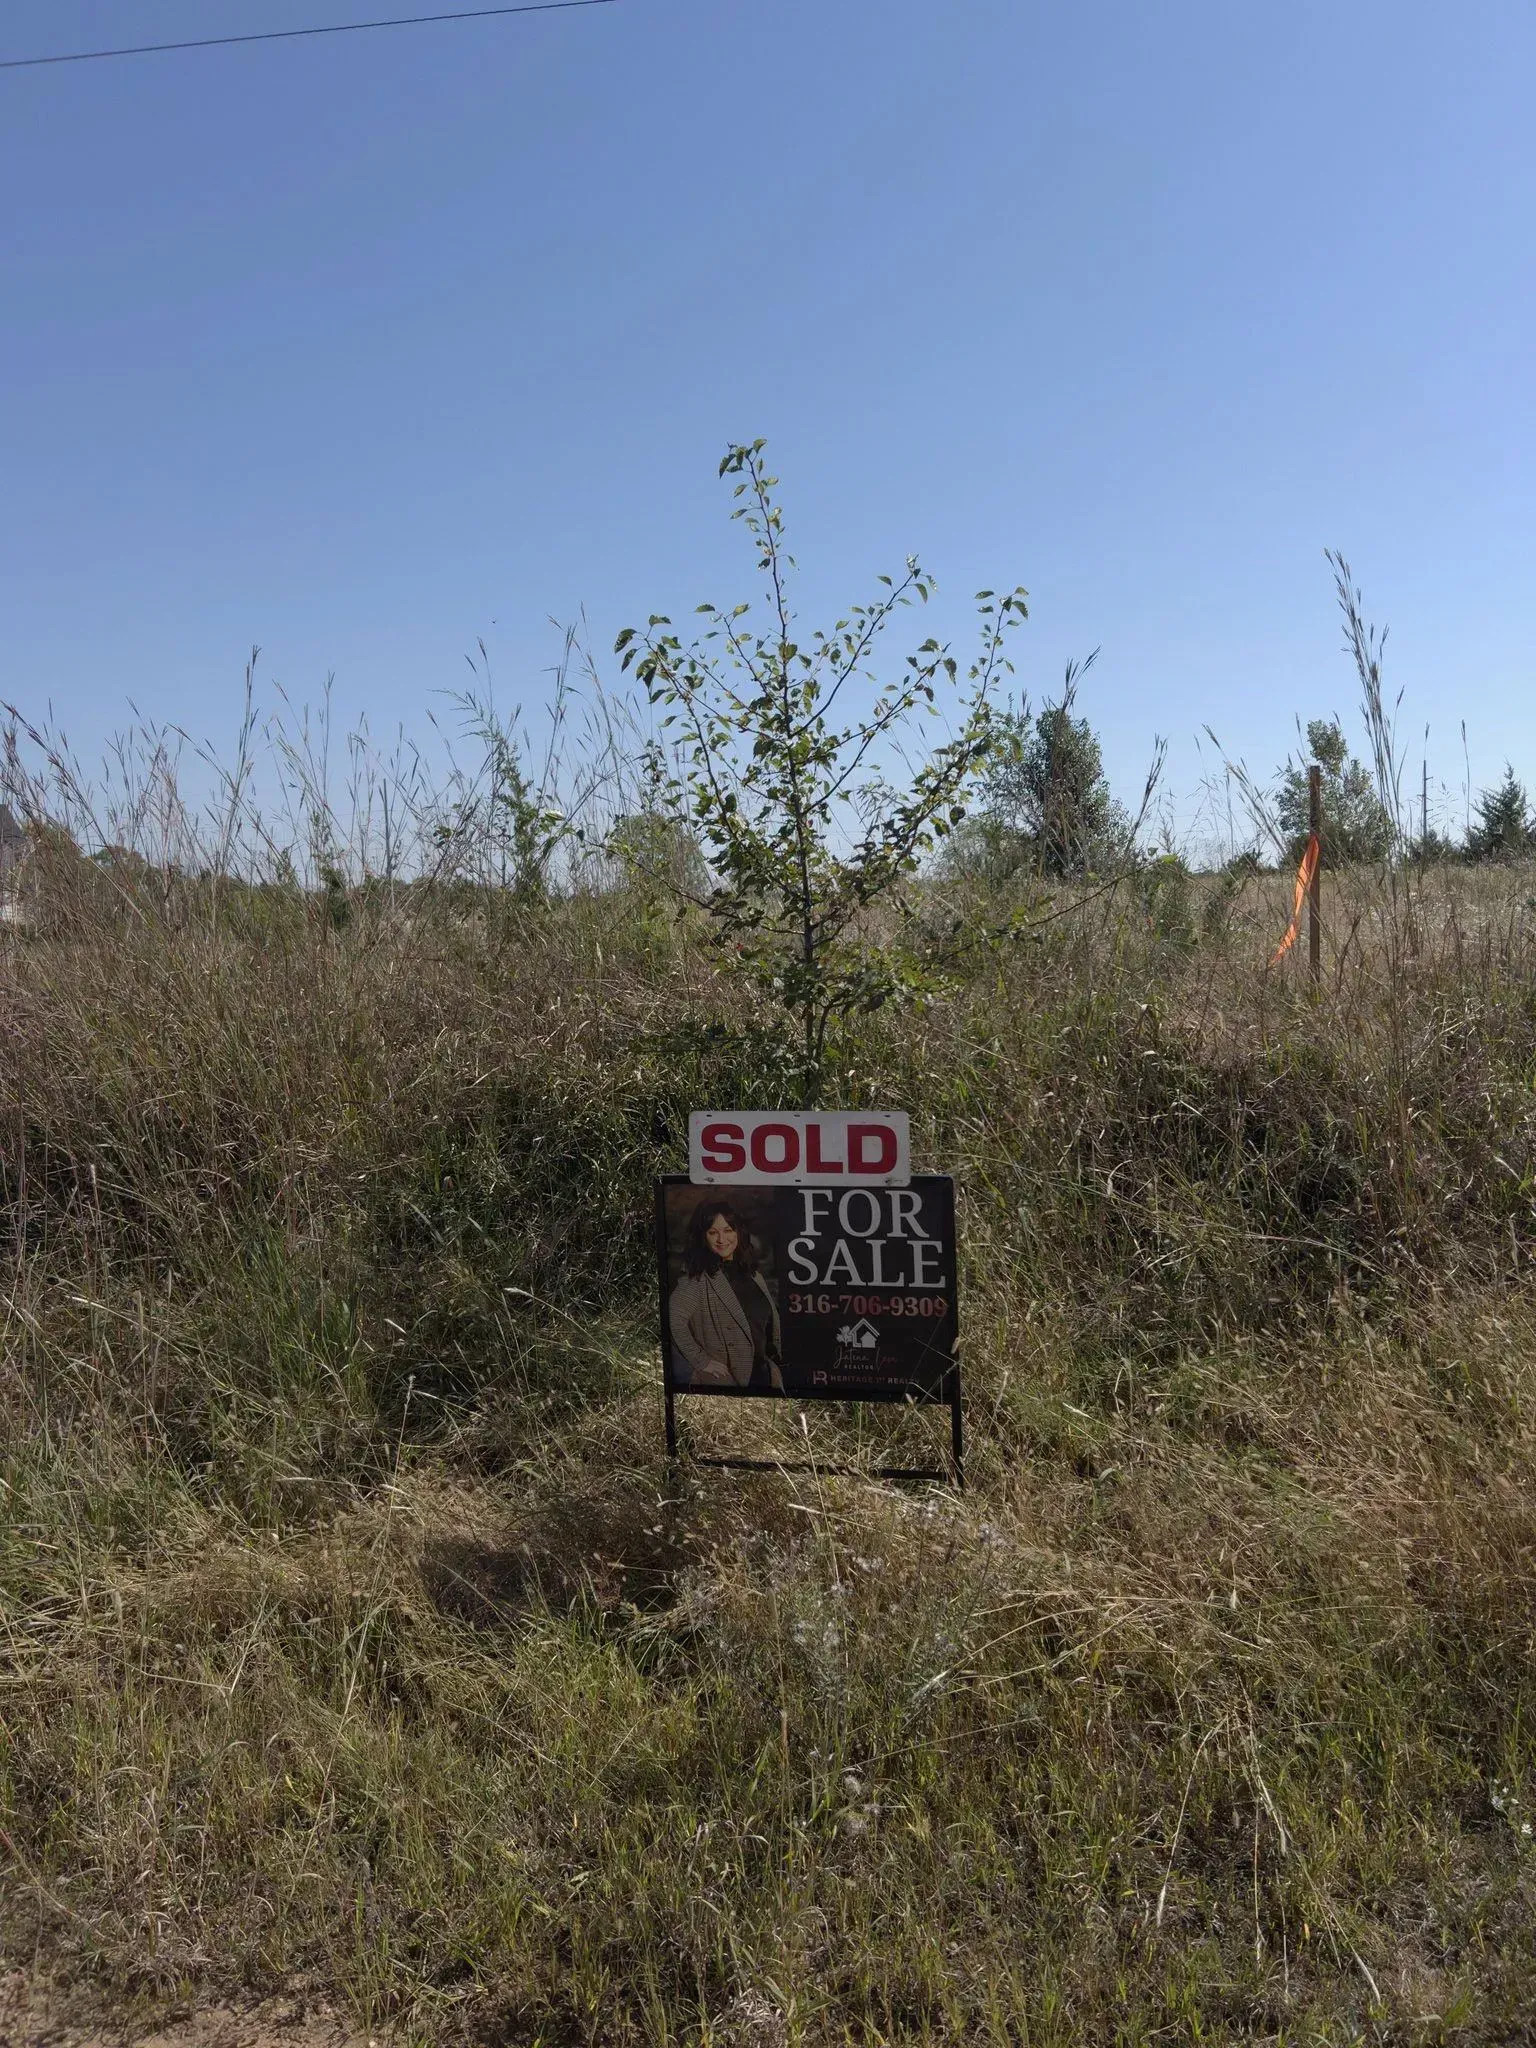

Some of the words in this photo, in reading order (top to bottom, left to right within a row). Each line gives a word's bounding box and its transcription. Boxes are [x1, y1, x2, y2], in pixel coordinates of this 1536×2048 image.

[701, 1123, 898, 1174] SOLD
[798, 1189, 930, 1238] FOR
[787, 1237, 946, 1288] SALE
[788, 1294, 948, 1317] 316-706-9309
[830, 1375, 874, 1383] HERITAGE
